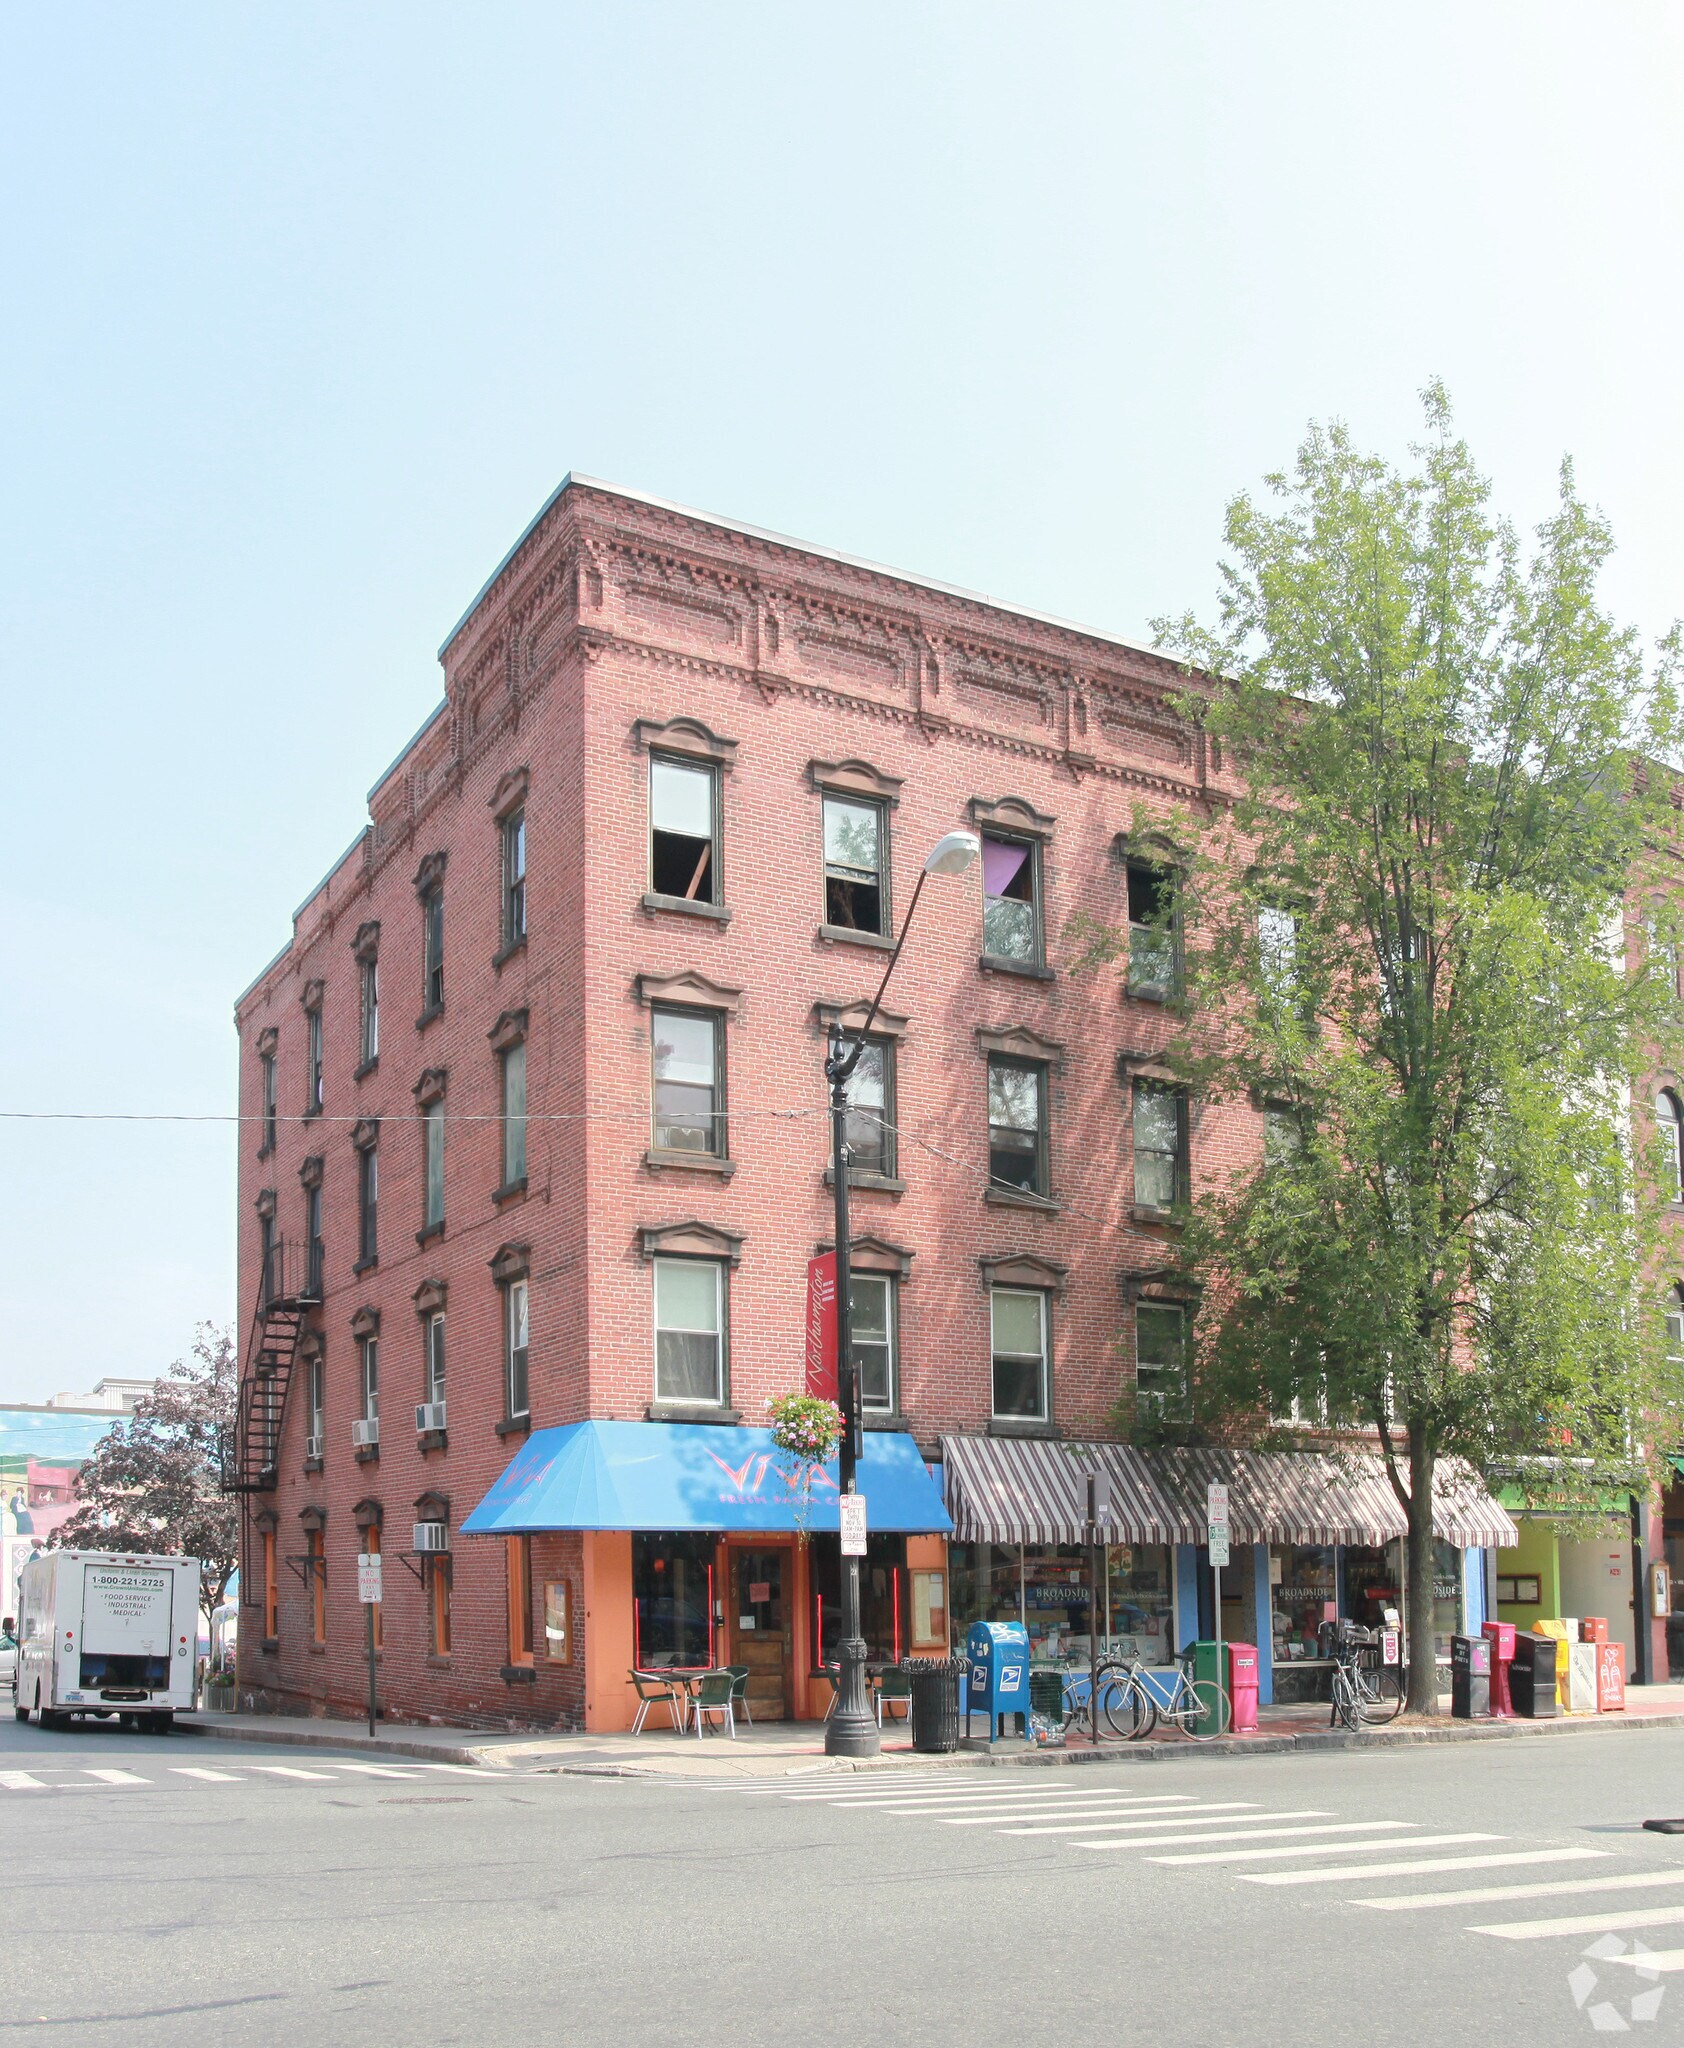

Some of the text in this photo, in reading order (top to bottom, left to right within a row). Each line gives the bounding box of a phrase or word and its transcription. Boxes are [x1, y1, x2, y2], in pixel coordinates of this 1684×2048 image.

[806, 1267, 826, 1387] Northampton
[1212, 1488, 1222, 1496] NO
[92, 1576, 165, 1587] 1-800-221-2725
[1036, 1588, 1089, 1598] BROADSID
[1279, 1587, 1329, 1597] BROADSIDE
[112, 1609, 142, 1617] MEDICAL
